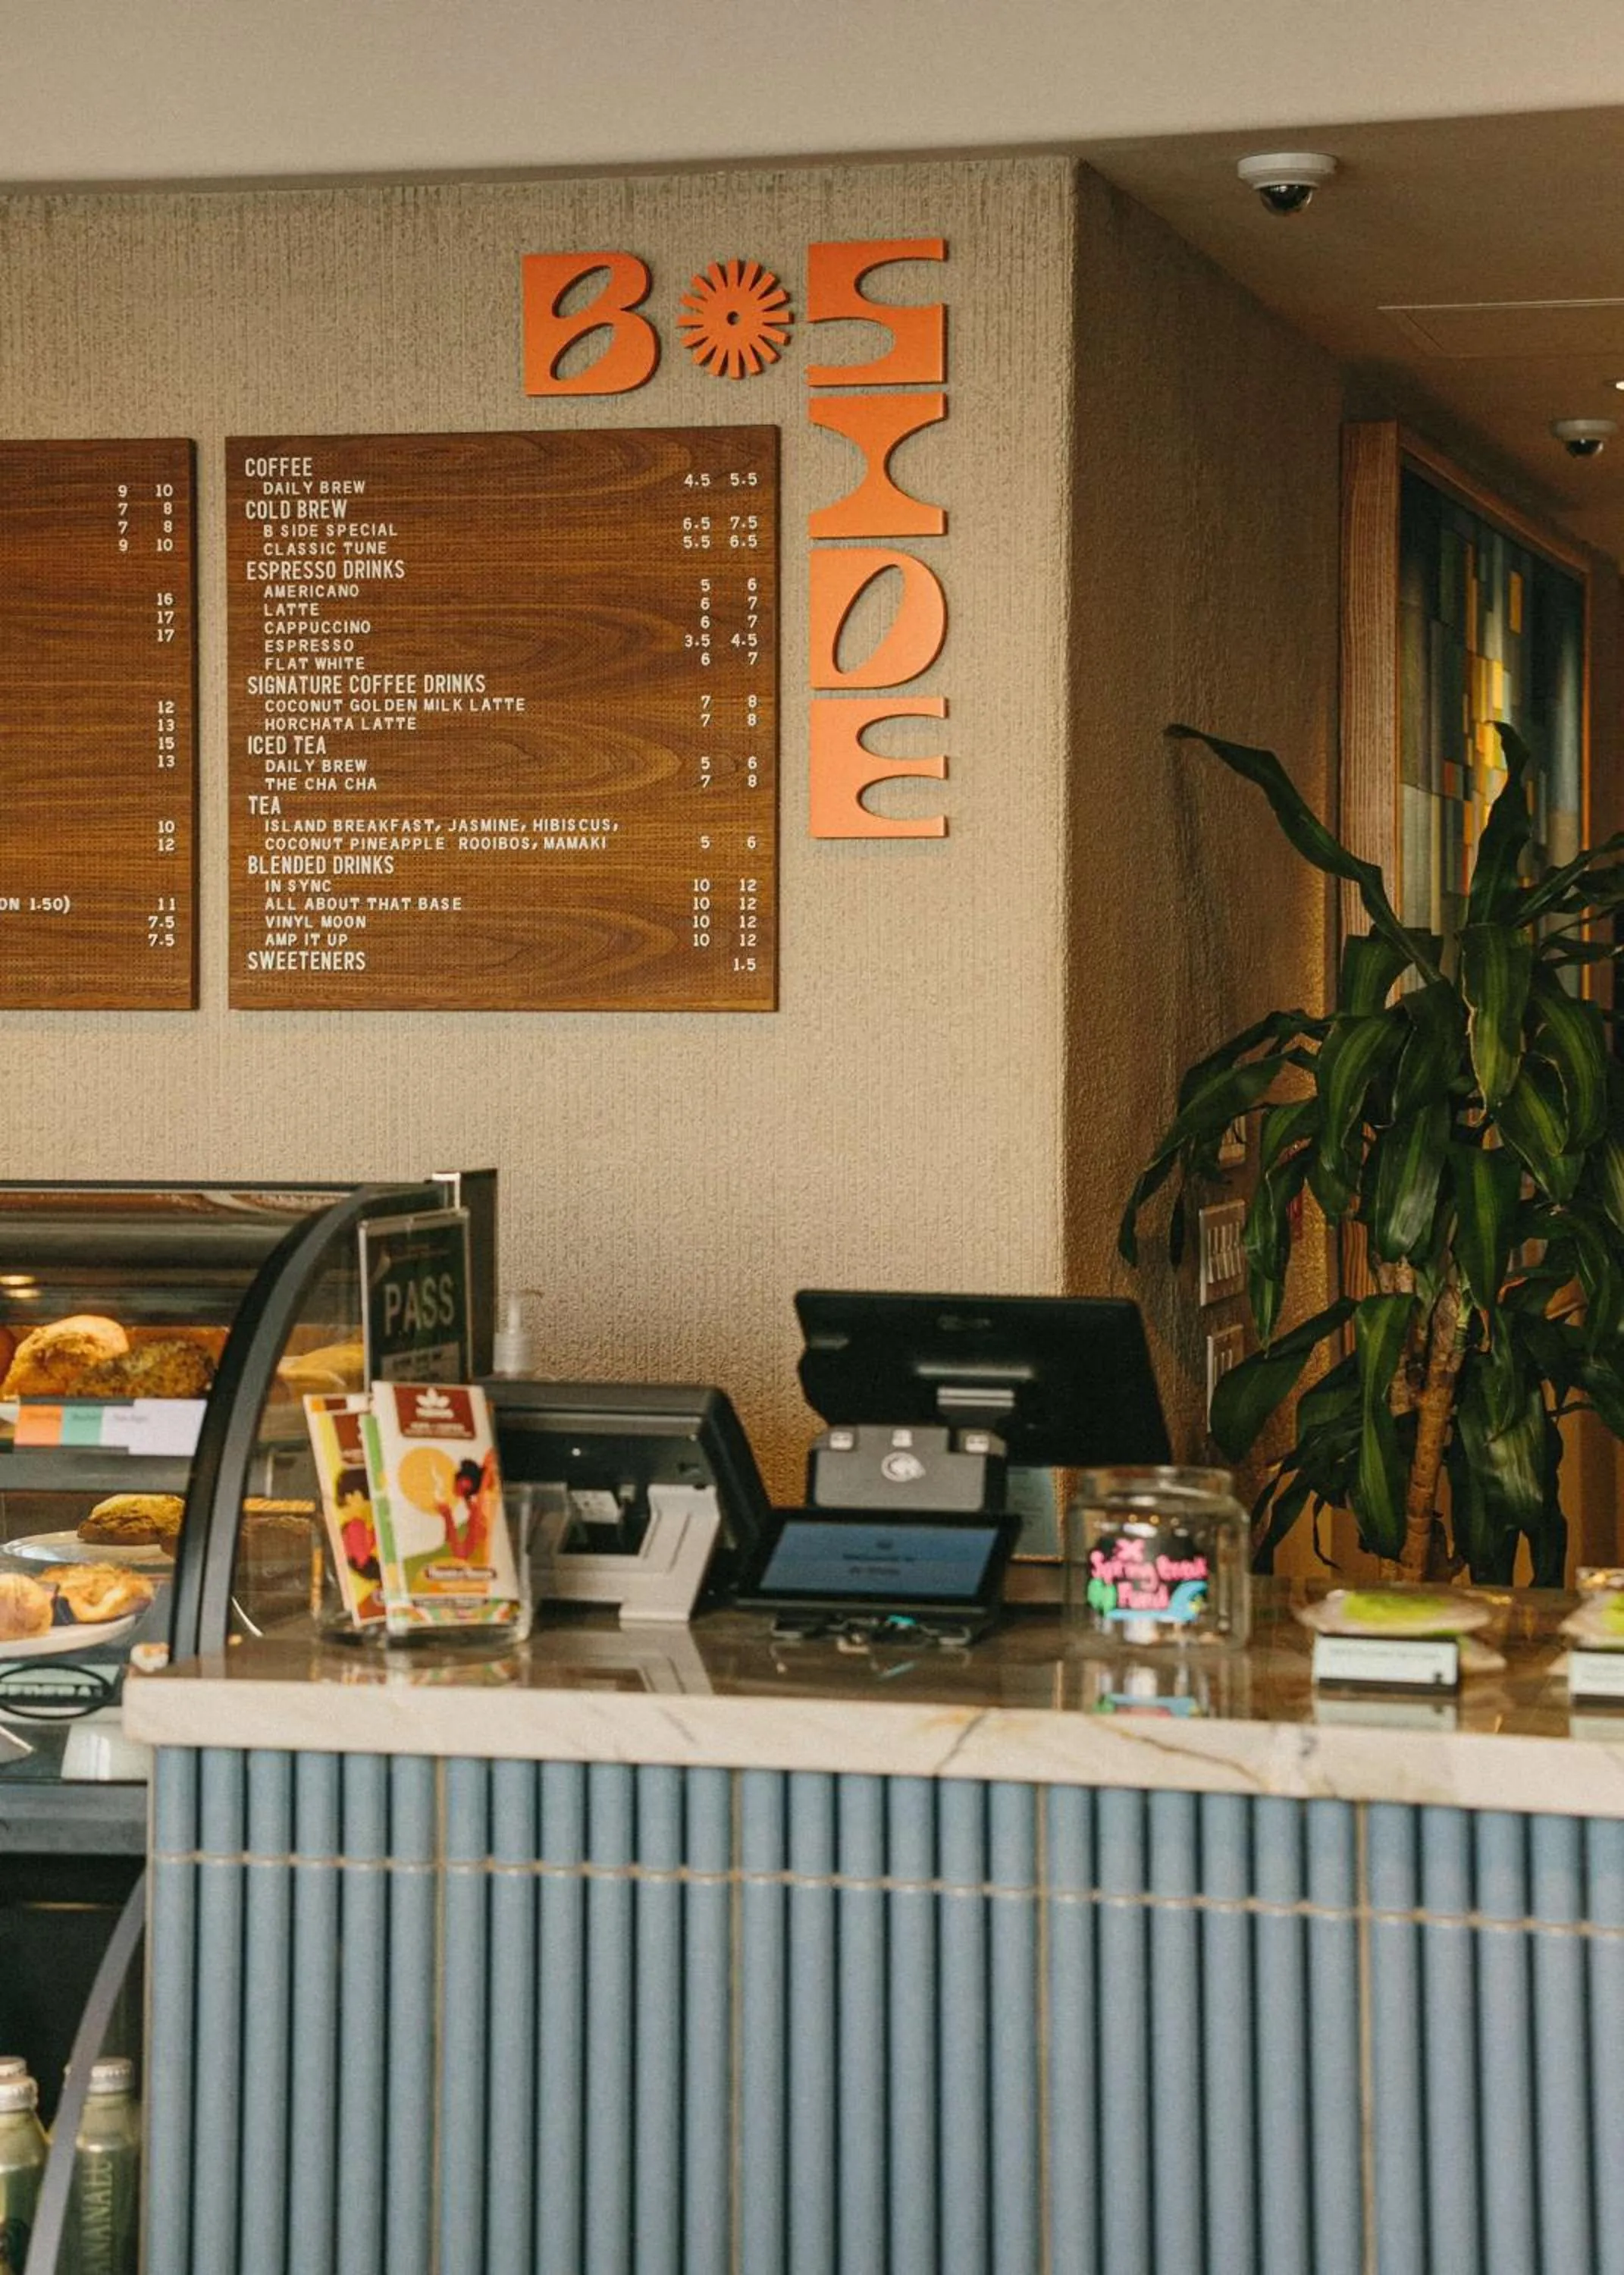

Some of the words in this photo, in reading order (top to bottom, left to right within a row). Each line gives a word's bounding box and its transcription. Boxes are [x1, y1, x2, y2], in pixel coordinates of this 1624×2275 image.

[522, 252, 659, 396] B
[245, 457, 312, 477] COFFEE
[263, 482, 313, 495] DAILY
[320, 480, 365, 494] BREW
[684, 473, 710, 488] 4.5
[730, 472, 757, 486] 5.5
[118, 485, 127, 498] 9
[156, 484, 173, 497] 10
[118, 503, 128, 516] 7
[163, 501, 172, 515] 8
[246, 500, 290, 519] COLD
[297, 498, 347, 519] BREW
[118, 521, 128, 534] 7
[163, 520, 172, 533] 8
[263, 524, 274, 538] B
[281, 524, 318, 538] SIDE
[326, 522, 397, 537] SPECIAL
[683, 516, 710, 531] 6.5
[730, 515, 757, 530] 7.5
[119, 538, 128, 551] 9
[157, 538, 173, 551] 10
[263, 541, 336, 556] CLASSIC
[343, 541, 387, 555] TUNE
[683, 535, 710, 549] 5.5
[729, 534, 757, 548] 6.5
[246, 560, 336, 580] ESPRESSO
[343, 560, 405, 579] DRINKS
[264, 584, 359, 598] AMERICANO
[701, 579, 710, 592] 5
[747, 577, 757, 592] 6
[157, 592, 173, 606] 16
[701, 597, 710, 610] 6
[748, 595, 757, 610] 7
[157, 610, 174, 624] 17
[264, 603, 319, 617] LATTE
[264, 620, 371, 635] CAPPUCCINO
[701, 615, 710, 629] 6
[748, 614, 757, 629] 7
[158, 629, 174, 642] 17
[685, 633, 710, 648] 3.5
[731, 633, 757, 648] 4.5
[265, 639, 354, 653] ESPRESSO
[265, 657, 309, 671] FLAT
[315, 656, 365, 670] WHITE
[701, 652, 710, 666] 6
[748, 651, 758, 665] 7
[247, 675, 343, 695] SIGNATURE
[350, 674, 416, 694] COFFEE
[424, 673, 486, 694] DRINKS
[158, 701, 174, 714] 12
[265, 698, 343, 713] COCONUT
[350, 698, 418, 713] GOLDEN
[423, 698, 462, 712] MILK
[469, 697, 525, 711] LATTE
[701, 695, 710, 709] 7
[748, 694, 757, 708] 8
[158, 718, 175, 732] 13
[265, 717, 354, 732] HORCHATA
[361, 717, 416, 730] LATTE
[701, 714, 710, 727] 7
[747, 713, 757, 726] 8
[158, 736, 175, 750] 15
[248, 735, 287, 755] ICED
[293, 735, 327, 755] TEA
[158, 755, 175, 768] 13
[265, 759, 315, 773] DAILY
[321, 759, 368, 773] BREW
[701, 756, 710, 770] 5
[748, 755, 757, 770] 6
[265, 777, 297, 791] THE
[304, 777, 337, 791] CHA
[344, 777, 377, 791] CHA
[701, 774, 711, 788] 7
[748, 774, 757, 788] 8
[248, 795, 281, 815] TEA
[158, 820, 175, 833] 10
[265, 819, 327, 833] ISLAND
[333, 818, 441, 833] BREAKFAST,
[448, 818, 527, 832] JASMINE,
[533, 818, 619, 832] HIBISCUS,
[158, 837, 175, 852] 12
[265, 836, 343, 851] COCONUT
[350, 836, 444, 851] PINEAPPLE
[459, 836, 538, 850] ROOIBOS,
[544, 836, 606, 850] MAMAKI
[701, 836, 710, 849] 5
[747, 835, 756, 849] 6
[248, 855, 326, 874] BLENDED
[333, 855, 394, 875] DRINKS
[265, 879, 281, 893] IN
[287, 879, 331, 893] SYNC
[694, 878, 710, 893] 10
[739, 878, 757, 893] 12
[30, 895, 71, 914] 1.50)
[158, 897, 175, 911] 11
[265, 897, 296, 911] ALL
[304, 897, 360, 911] ABOUT
[366, 897, 412, 911] THAT
[418, 897, 462, 911] BASE
[693, 896, 710, 911] 10
[739, 897, 757, 911] 12
[148, 915, 175, 929] 7.5
[265, 915, 313, 928] VINYL
[321, 915, 366, 929] MOON
[693, 915, 710, 929] 10
[739, 915, 757, 929] 12
[148, 934, 175, 947] 7.5
[265, 932, 297, 946] AMP
[304, 933, 321, 946] IT
[327, 934, 348, 947] UP
[693, 933, 710, 947] 10
[739, 934, 757, 947] 12
[247, 950, 366, 971] SWEETENERS
[733, 958, 756, 971] 1.5
[384, 1273, 454, 1337] PASS
